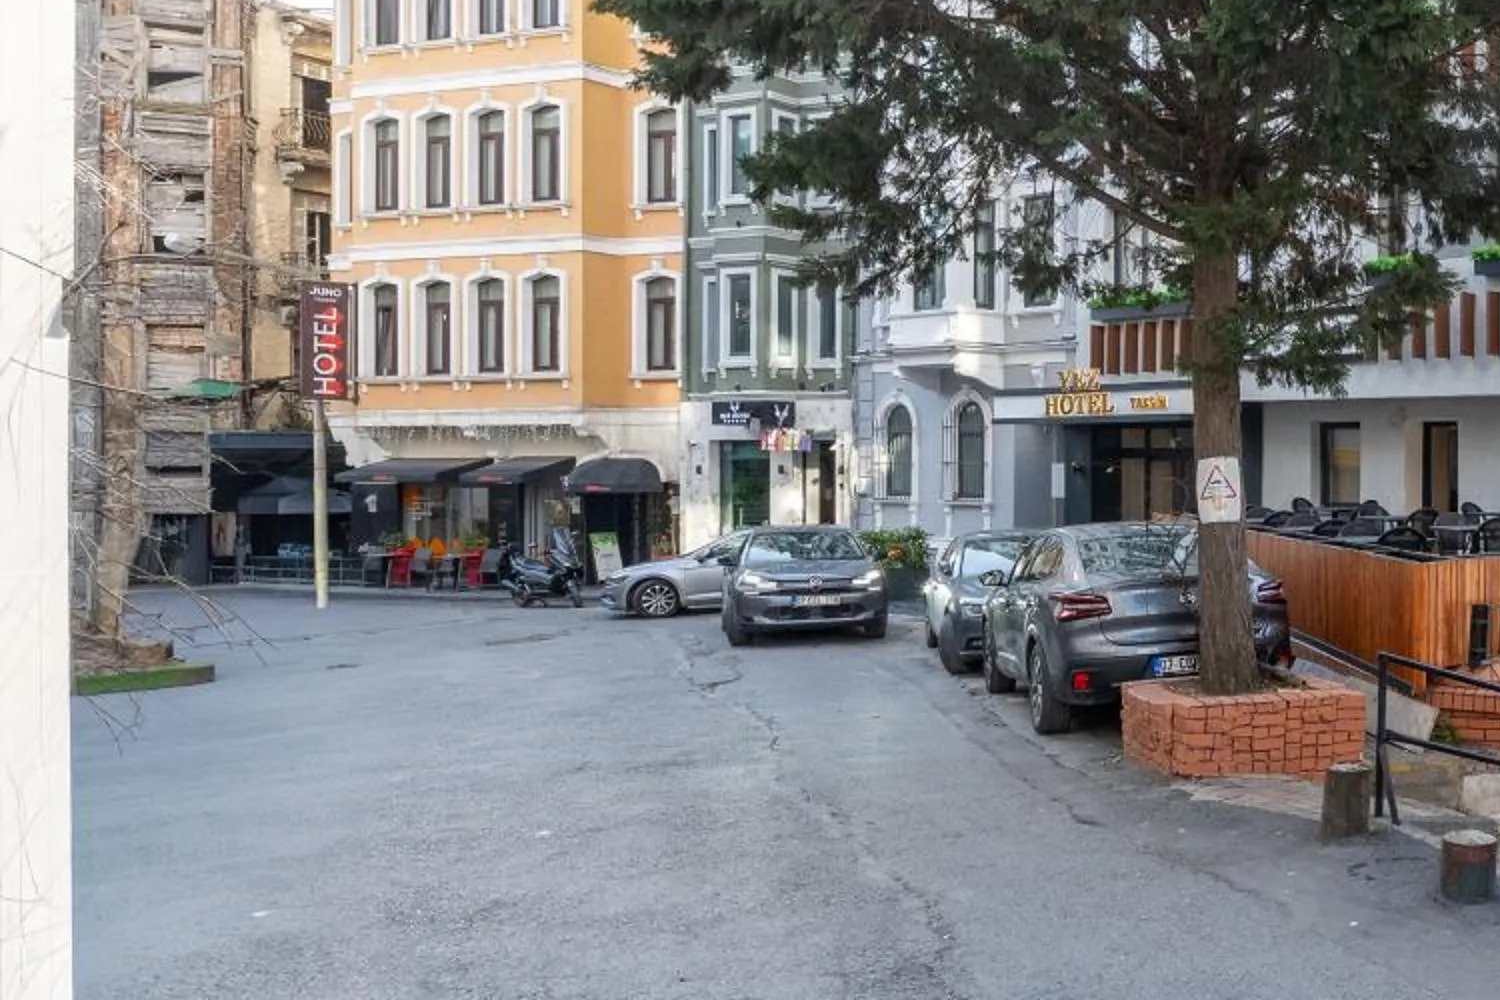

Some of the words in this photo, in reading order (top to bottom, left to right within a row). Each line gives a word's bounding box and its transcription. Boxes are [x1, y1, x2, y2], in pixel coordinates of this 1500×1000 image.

[309, 286, 342, 297] JUNO
[313, 306, 337, 395] HOTEL
[1045, 392, 1117, 416] HOTEL
